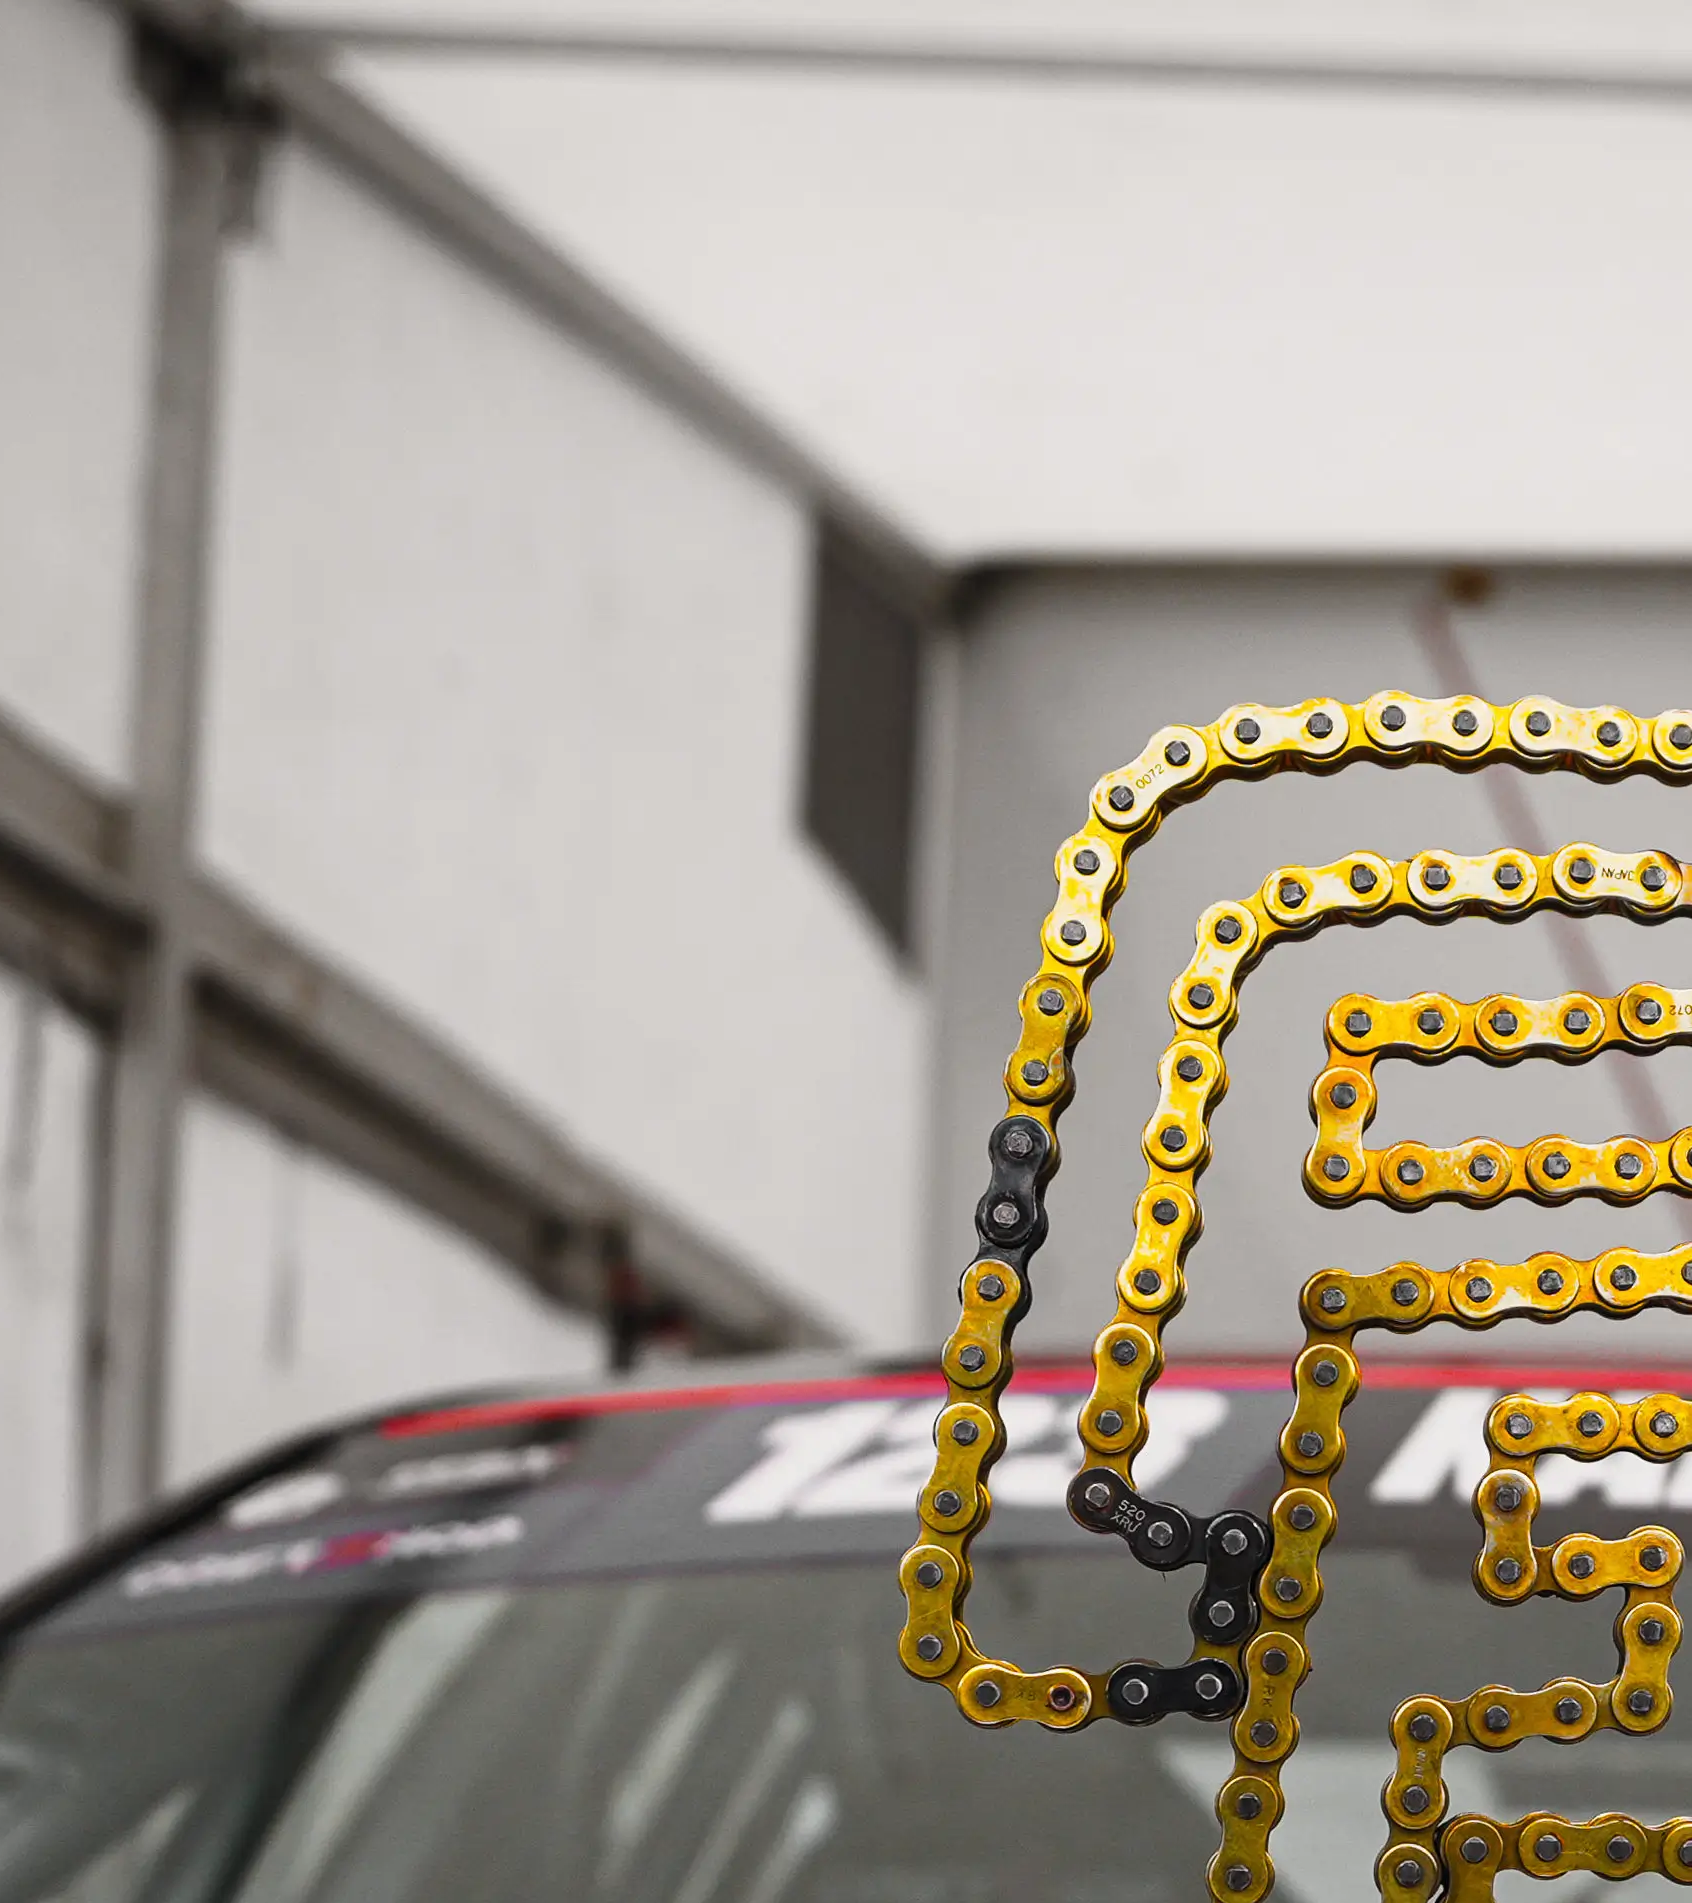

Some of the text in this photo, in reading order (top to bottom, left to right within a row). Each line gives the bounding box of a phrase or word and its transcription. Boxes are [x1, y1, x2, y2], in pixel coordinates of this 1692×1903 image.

[1135, 763, 1165, 789] 0072
[1601, 866, 1636, 882] JAPAN
[1118, 1499, 1146, 1521] 520
[1109, 1510, 1142, 1533] XRU
